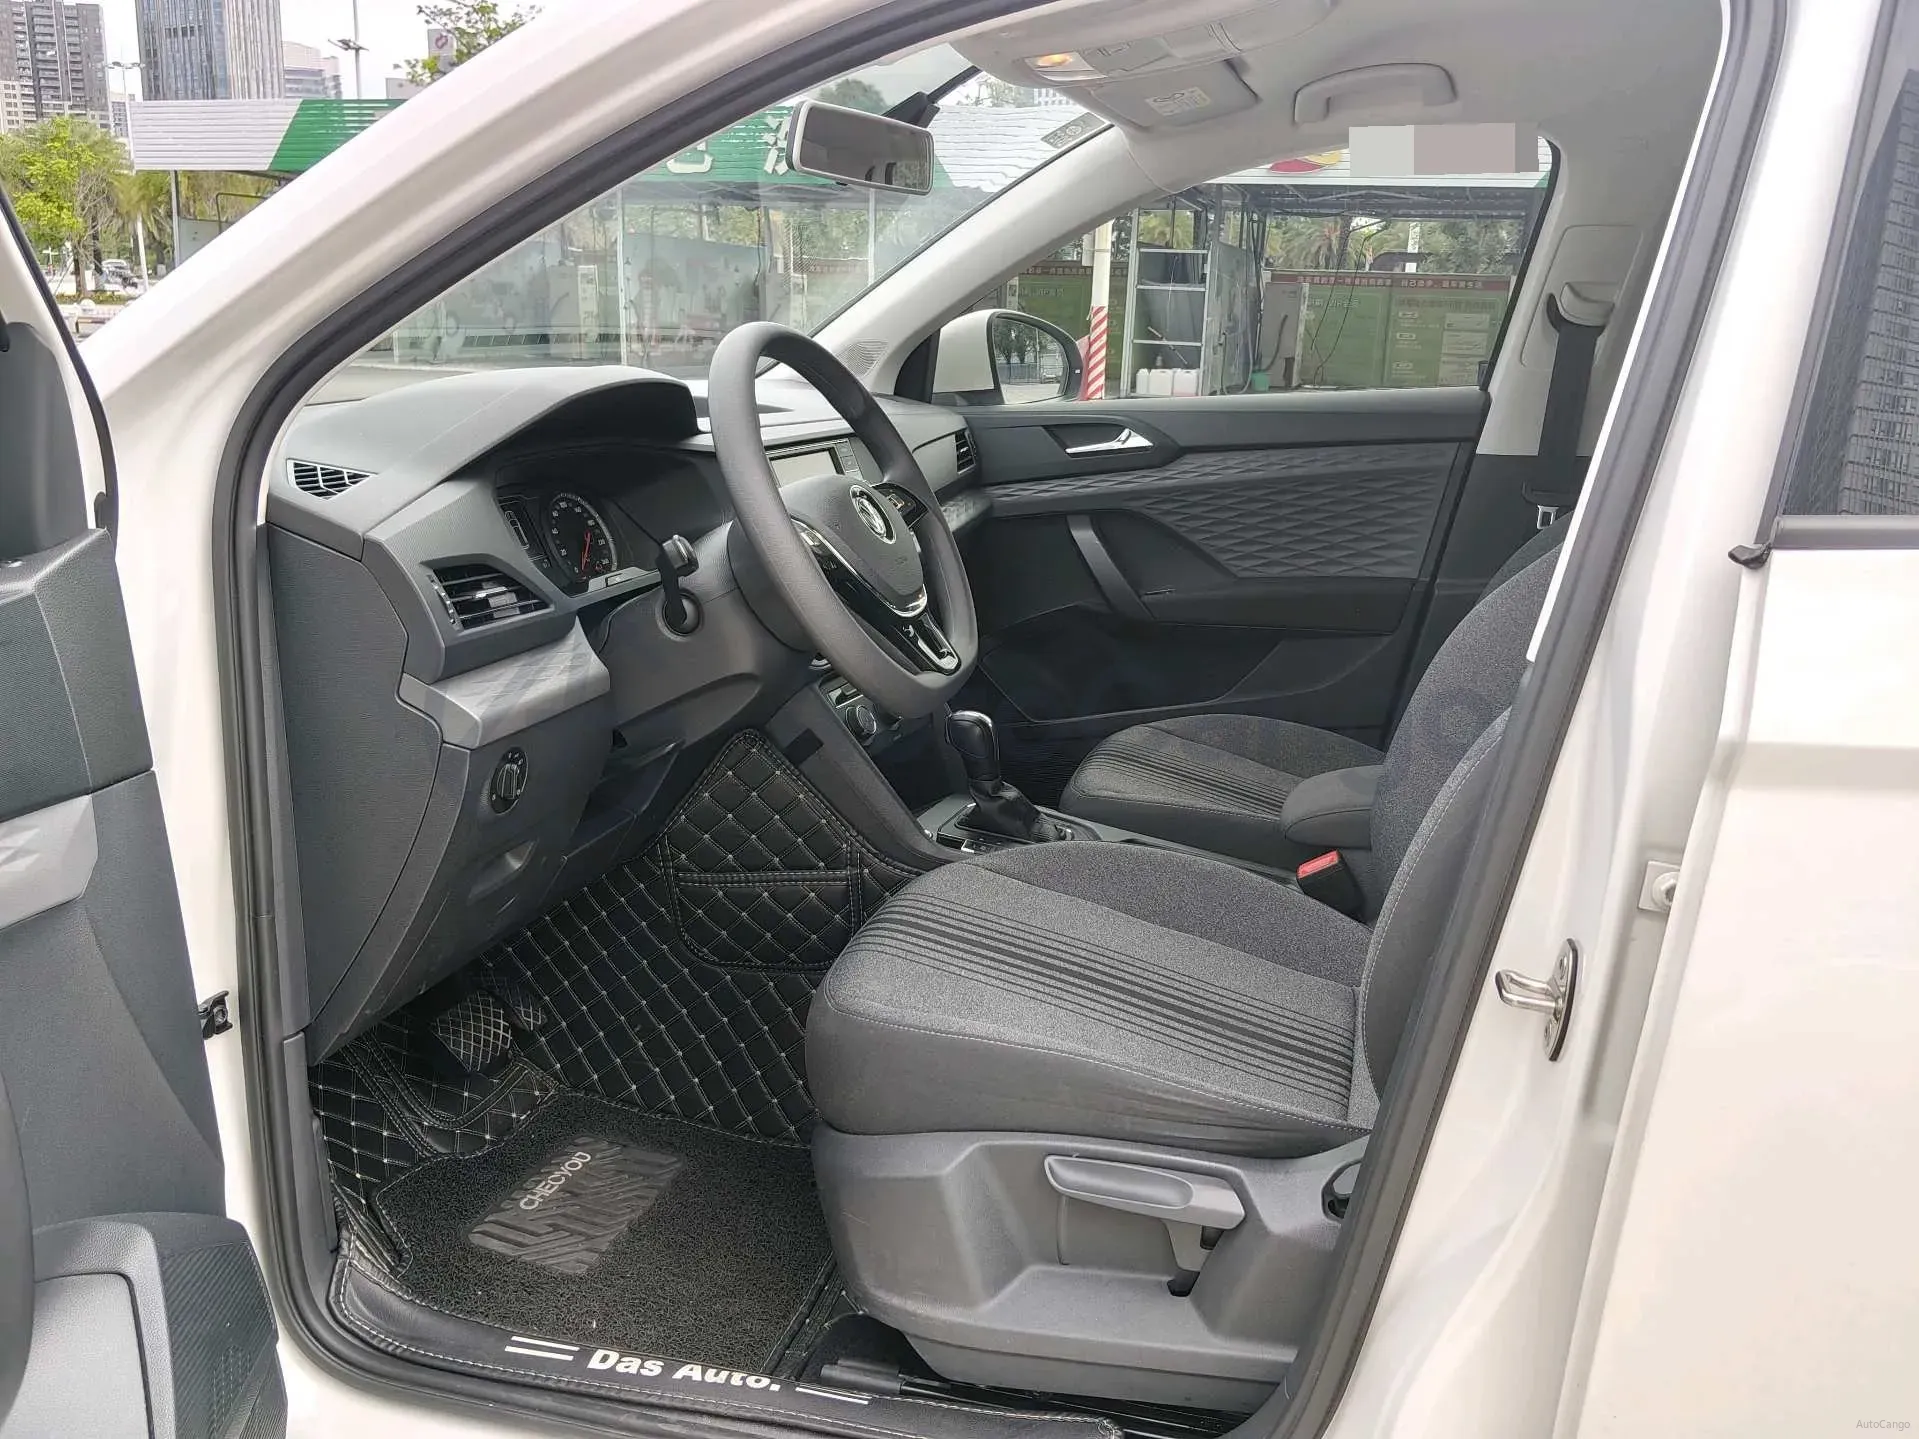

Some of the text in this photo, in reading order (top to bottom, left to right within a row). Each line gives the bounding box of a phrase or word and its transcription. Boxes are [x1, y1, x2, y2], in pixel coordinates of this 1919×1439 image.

[520, 1152, 591, 1209] CHECYOU
[587, 1349, 781, 1391] Das Auto.
